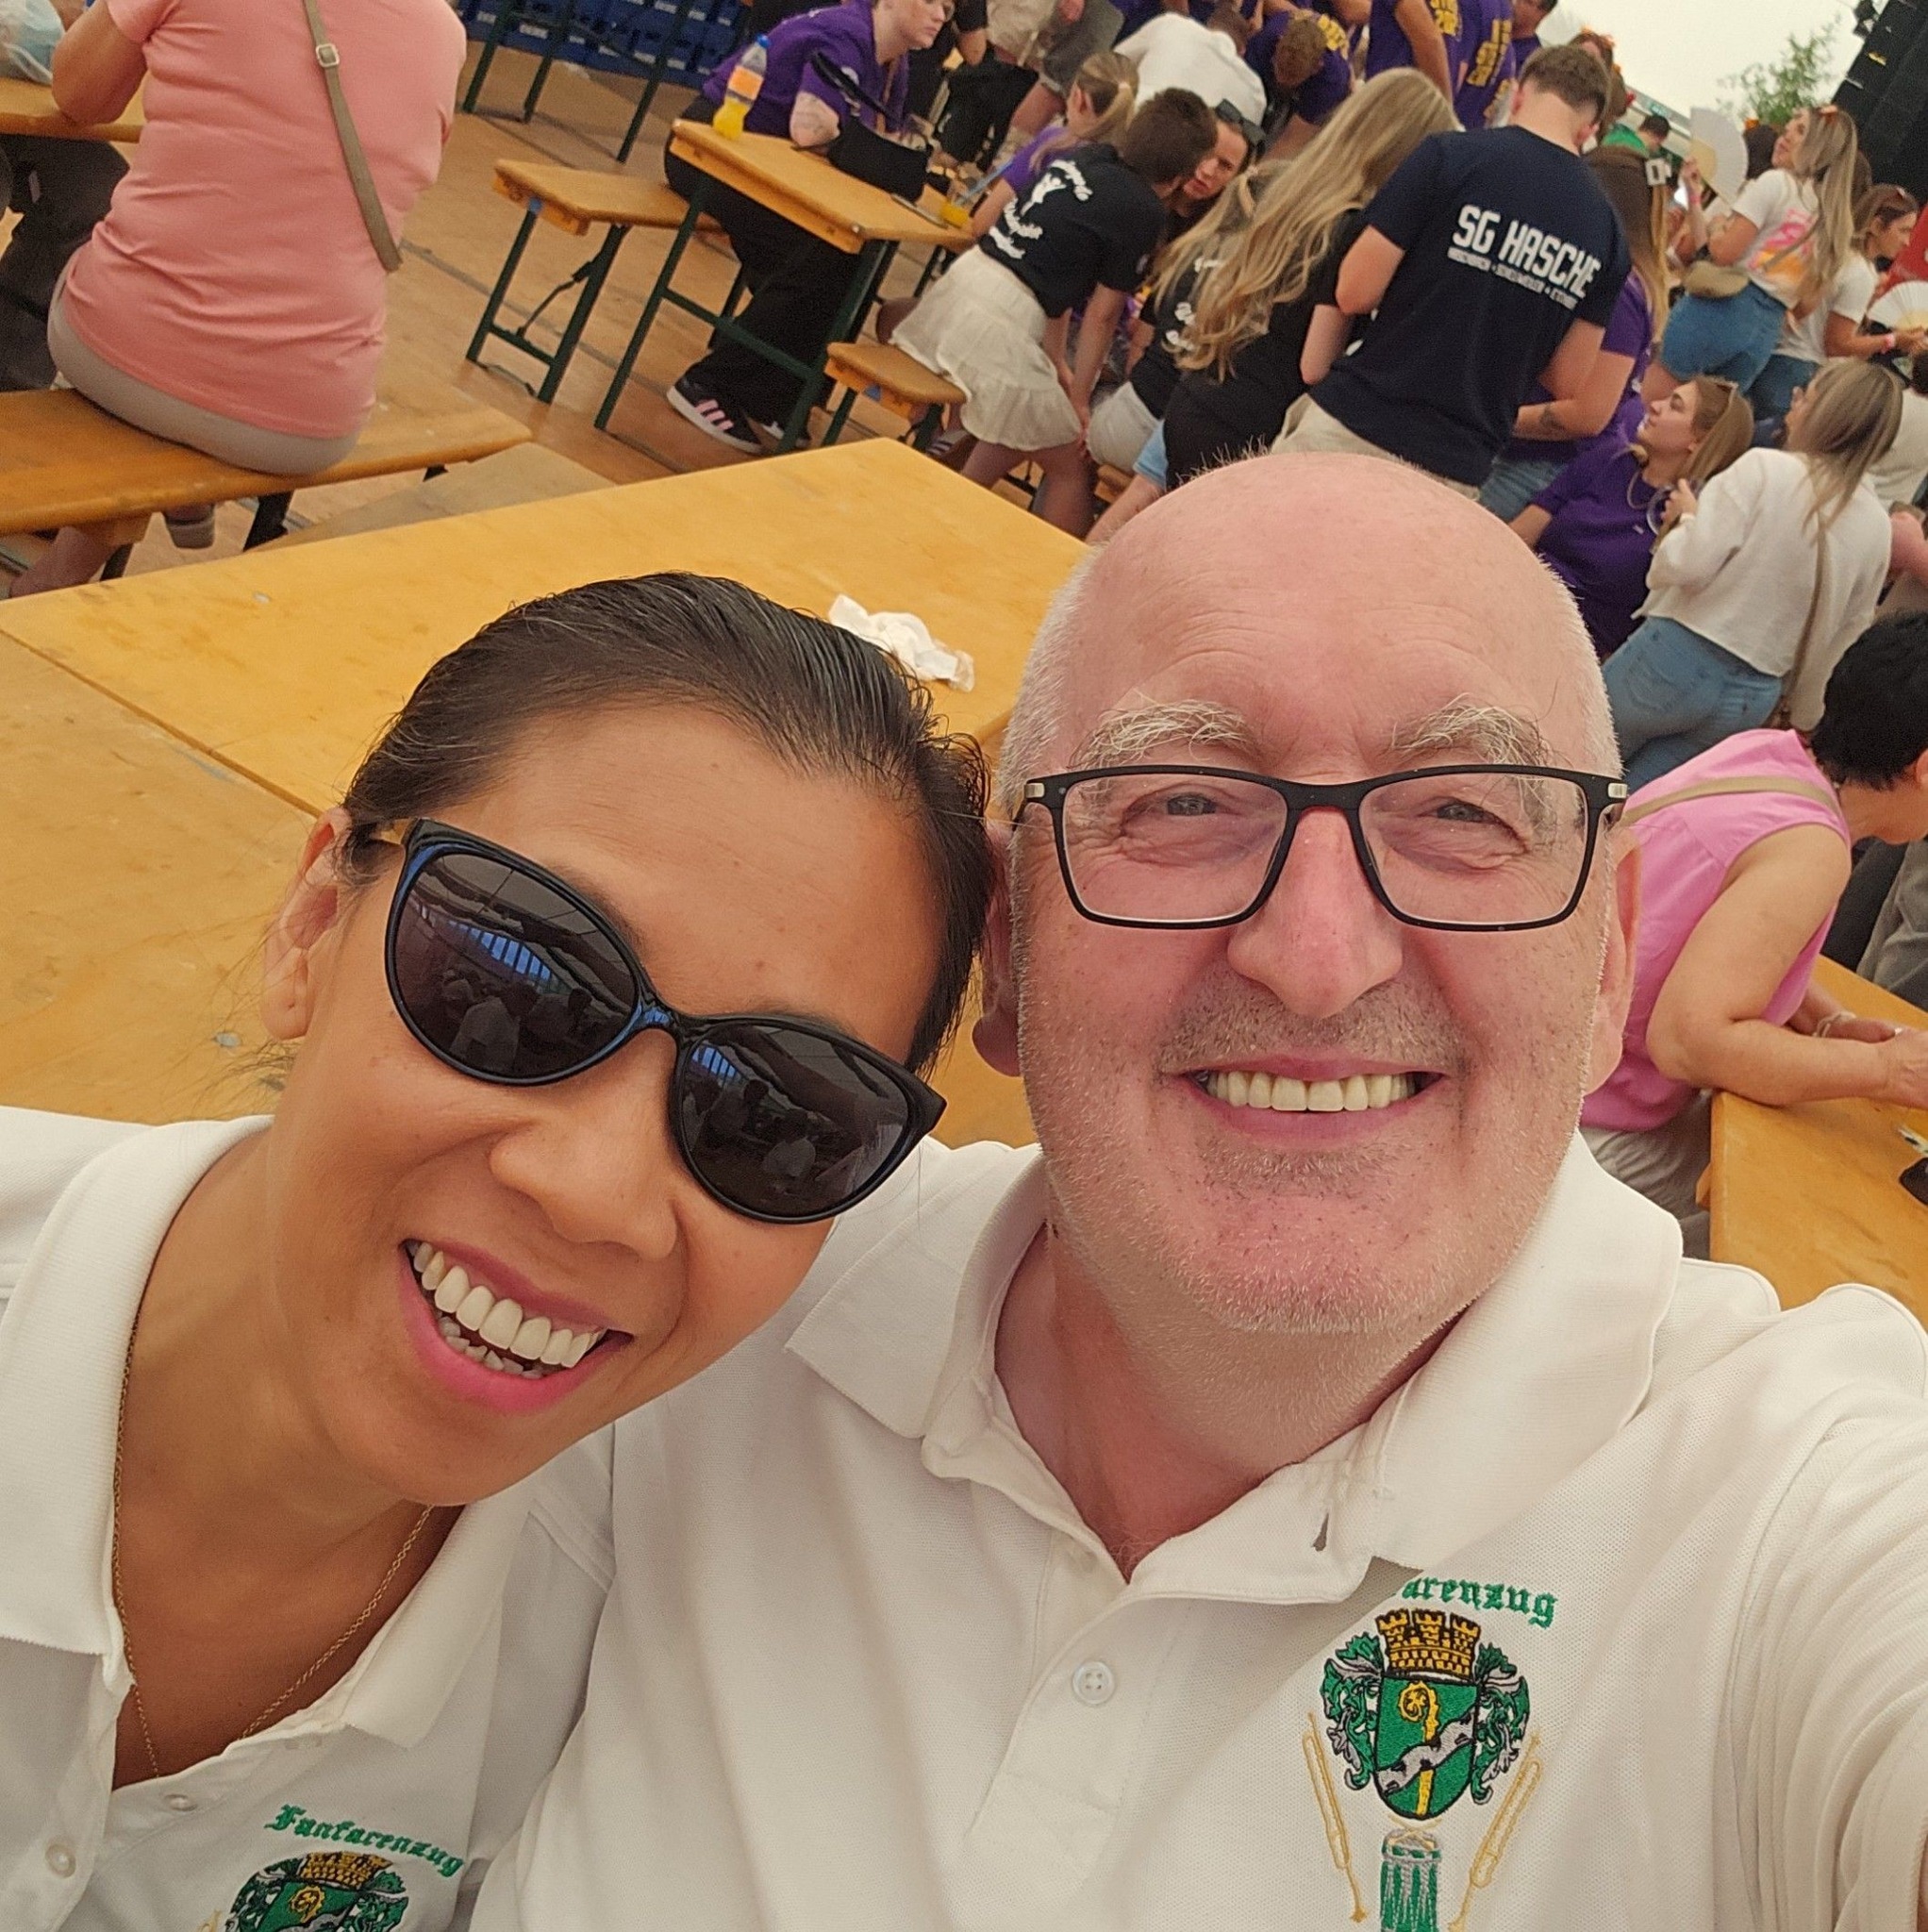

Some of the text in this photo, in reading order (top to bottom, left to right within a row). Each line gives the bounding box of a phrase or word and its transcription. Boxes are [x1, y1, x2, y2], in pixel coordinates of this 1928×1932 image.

[1452, 204, 1501, 255] SG
[1498, 220, 1602, 299] HASCHE
[1401, 1575, 1558, 1630] arenzug
[263, 1803, 465, 1878] Fanfarenzug
